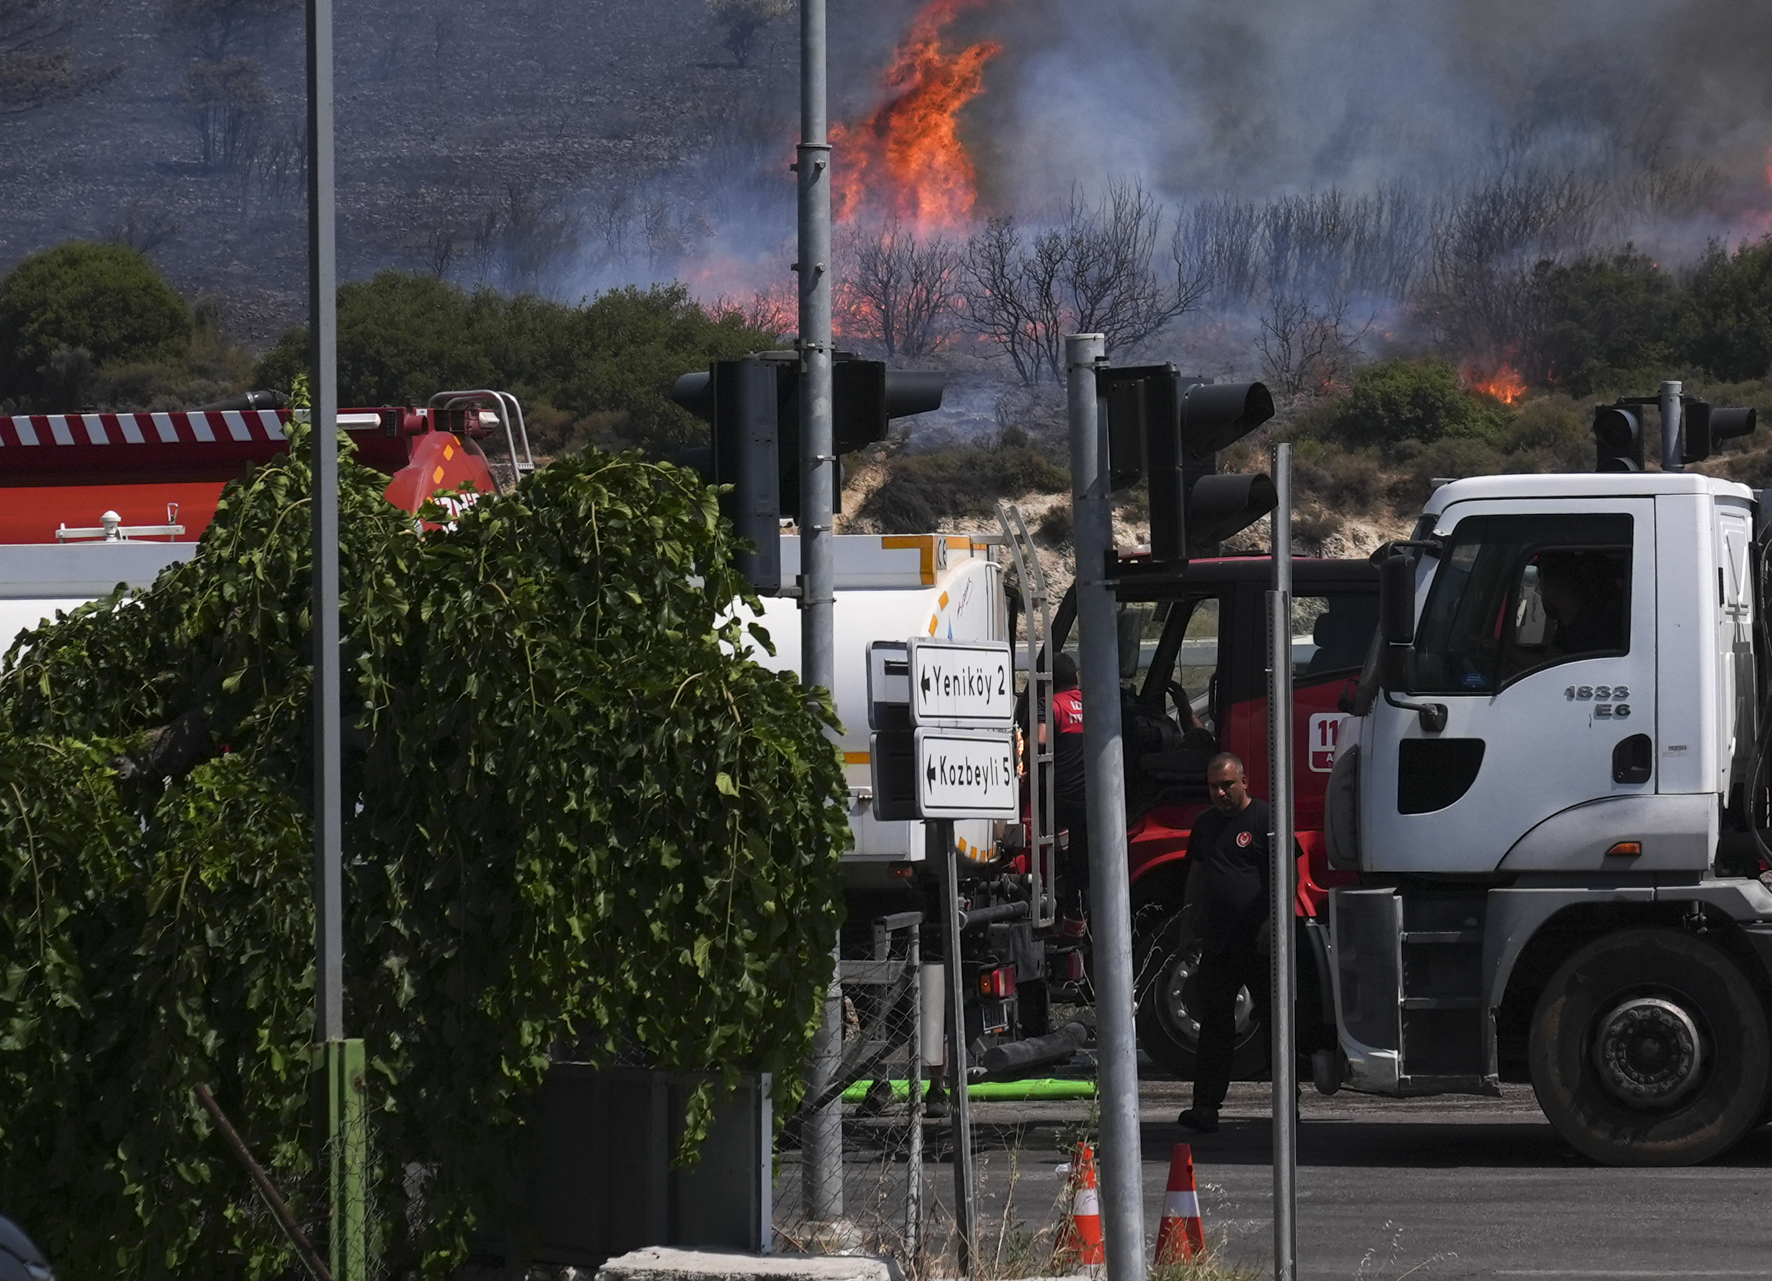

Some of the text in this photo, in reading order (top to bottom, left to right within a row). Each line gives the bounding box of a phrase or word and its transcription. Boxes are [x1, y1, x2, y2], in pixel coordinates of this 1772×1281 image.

[932, 665, 1006, 705] Yeniköy 2
[1595, 704, 1631, 717] E6
[939, 755, 1010, 795] Kozbeyli 5
